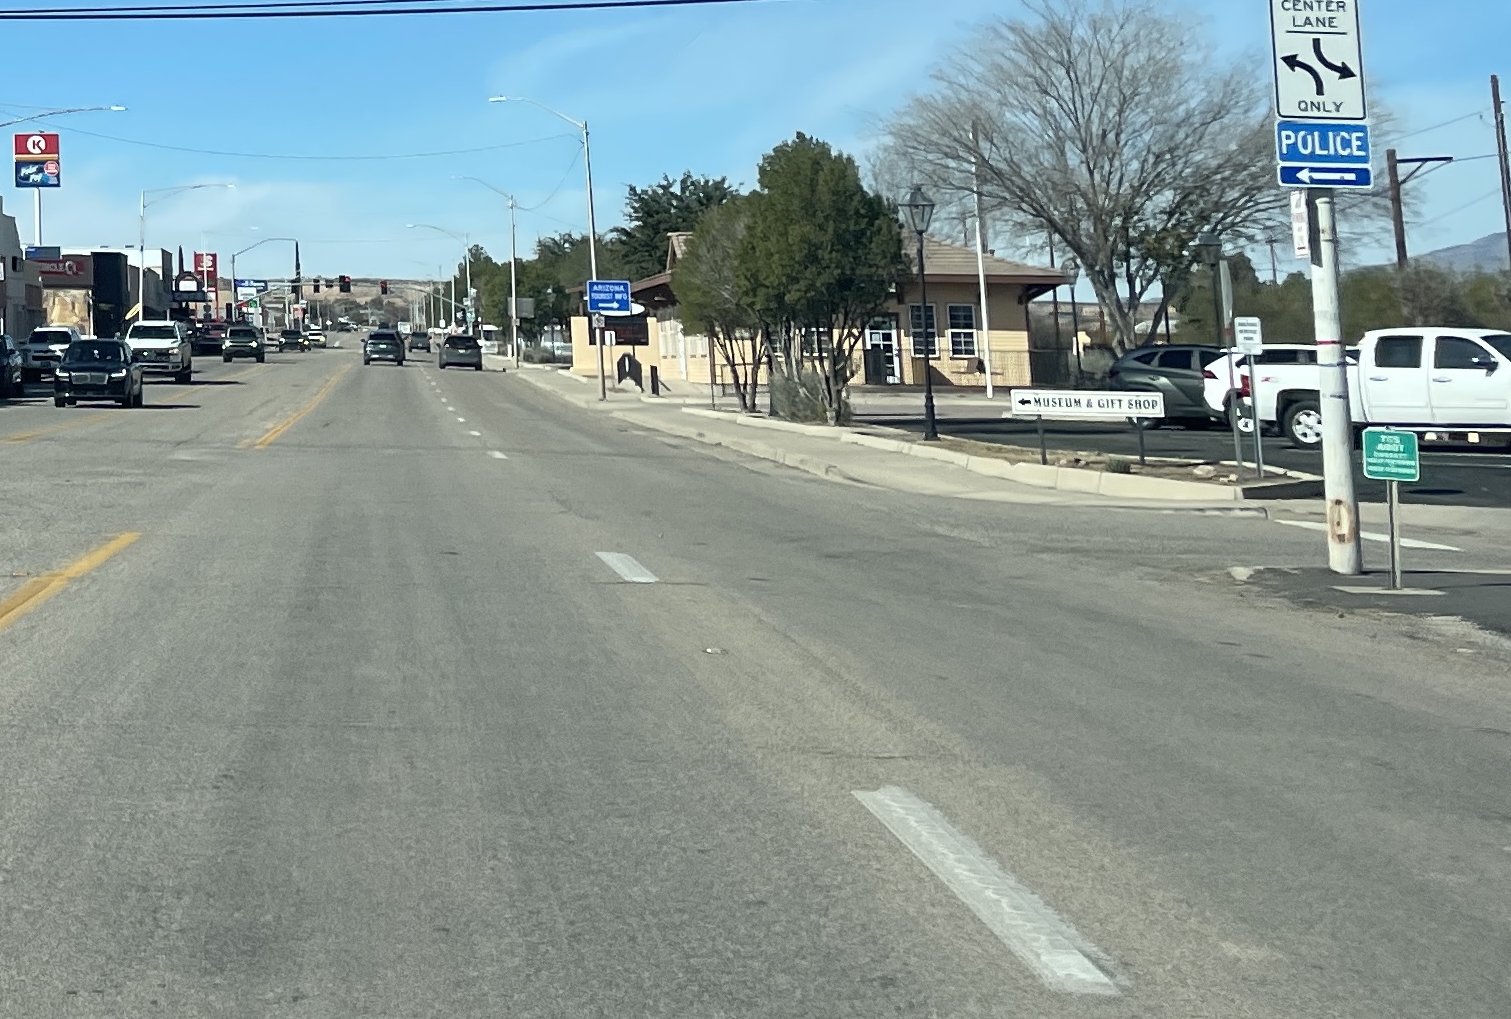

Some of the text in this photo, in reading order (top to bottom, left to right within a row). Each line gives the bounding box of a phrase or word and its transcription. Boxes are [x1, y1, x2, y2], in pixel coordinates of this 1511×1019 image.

[1281, 0, 1346, 13] CENTER
[1292, 15, 1338, 29] LANE
[1297, 99, 1344, 114] ONLY
[1280, 130, 1366, 157] POLICE
[592, 284, 625, 292] ARIZONA
[1033, 396, 1159, 410] MUSEUM & GIFT SHOP
